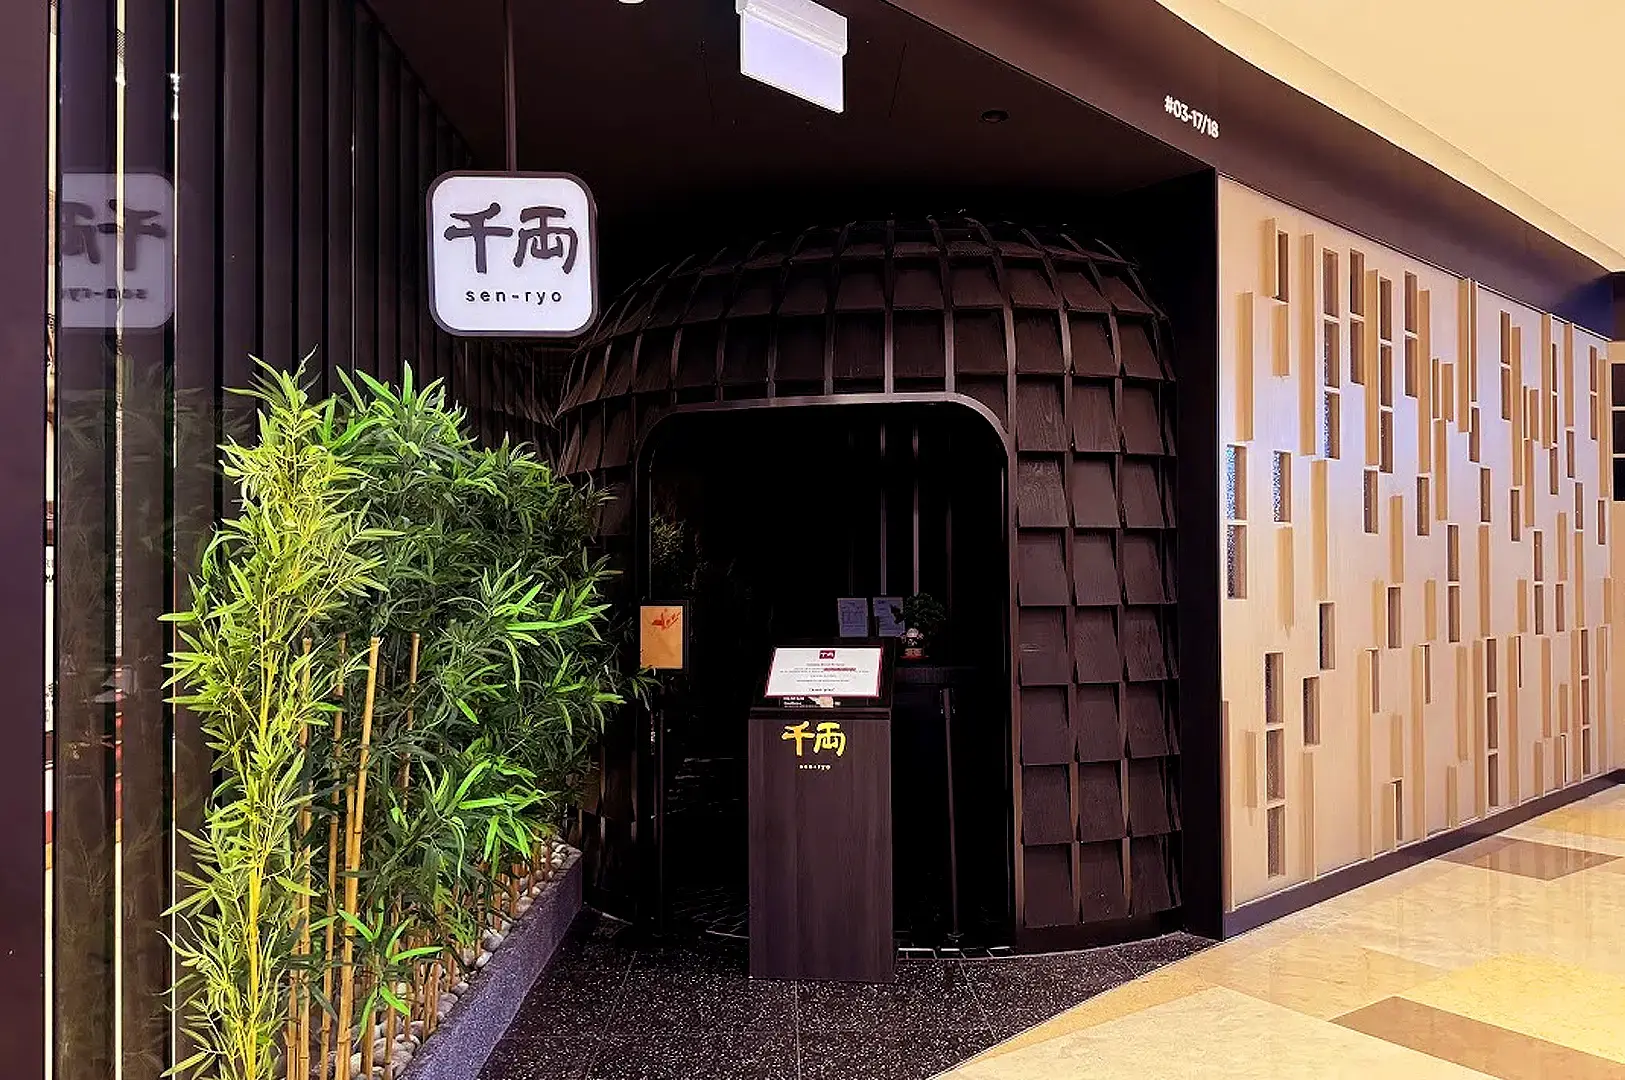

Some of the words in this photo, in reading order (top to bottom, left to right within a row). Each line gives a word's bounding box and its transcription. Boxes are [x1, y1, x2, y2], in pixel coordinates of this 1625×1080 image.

[1164, 94, 1219, 139] #03-17/18
[444, 202, 579, 275] 千両
[465, 290, 562, 306] sen-ryo
[781, 721, 847, 757] 千両
